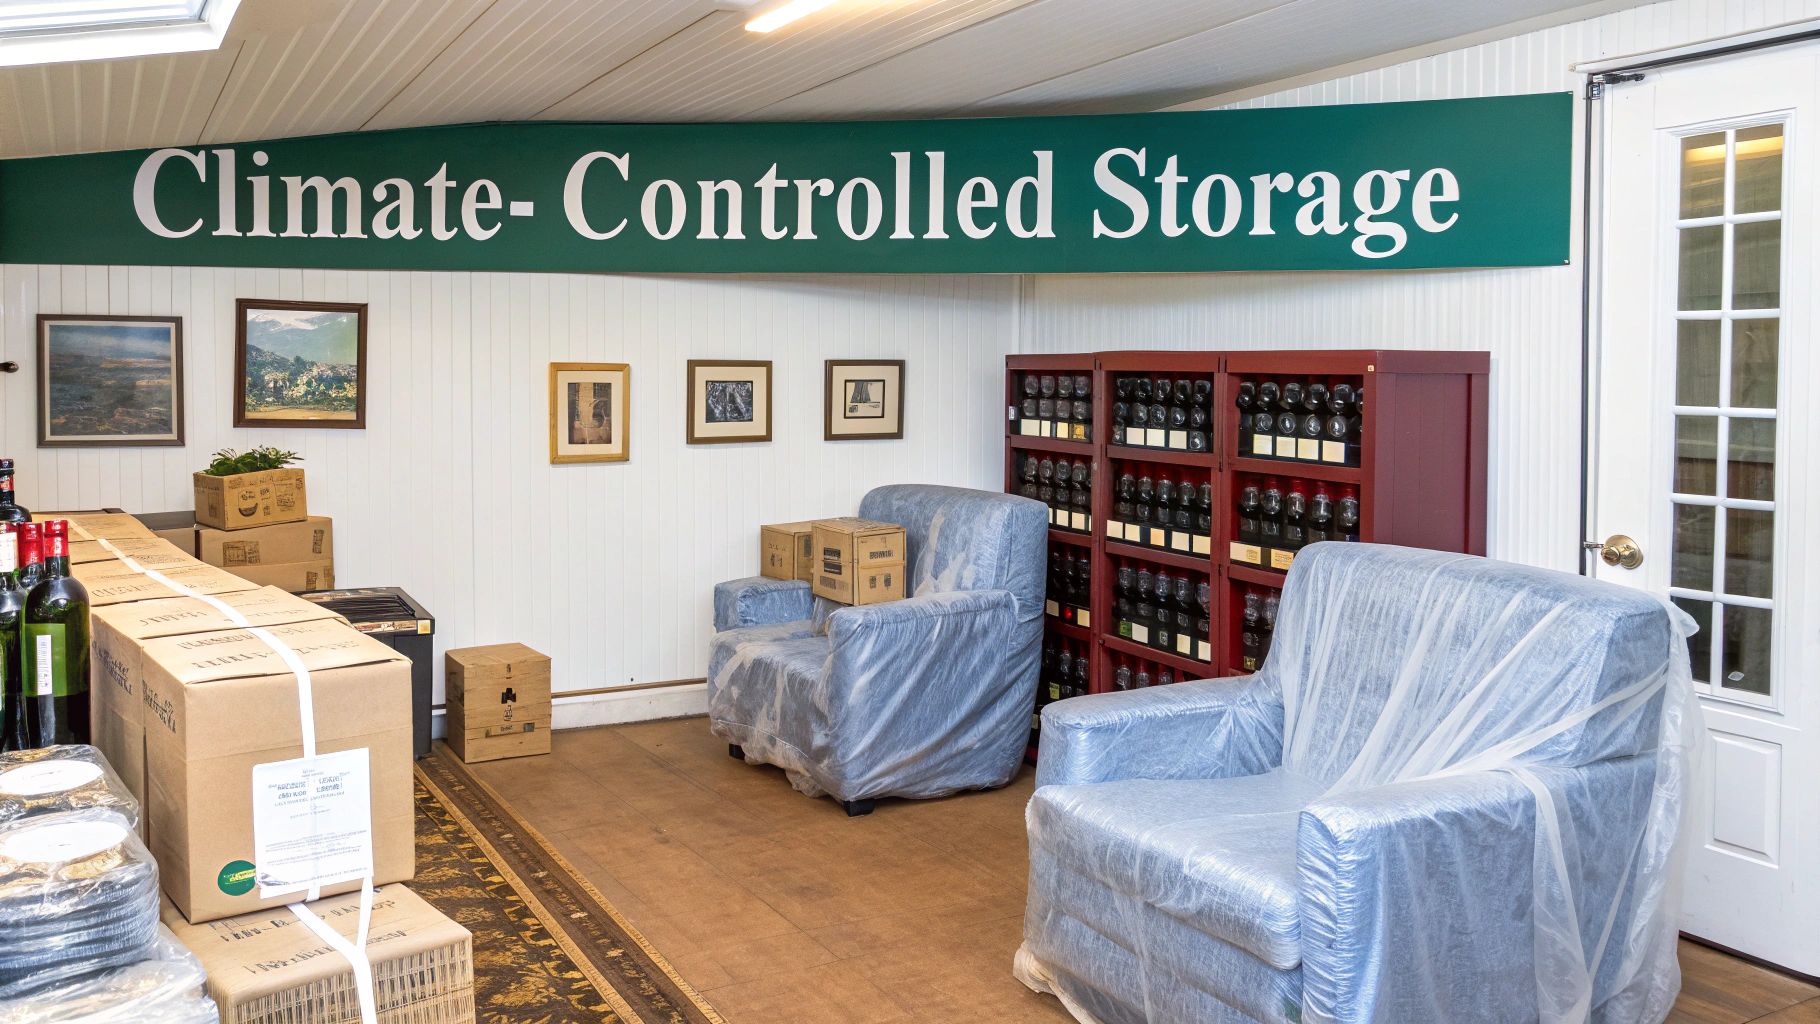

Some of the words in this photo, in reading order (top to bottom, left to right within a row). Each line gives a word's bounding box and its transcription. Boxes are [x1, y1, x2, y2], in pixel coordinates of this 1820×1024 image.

[133, 148, 534, 241] Climate-
[563, 149, 1056, 241] Controlled
[1093, 146, 1460, 259] Storage
